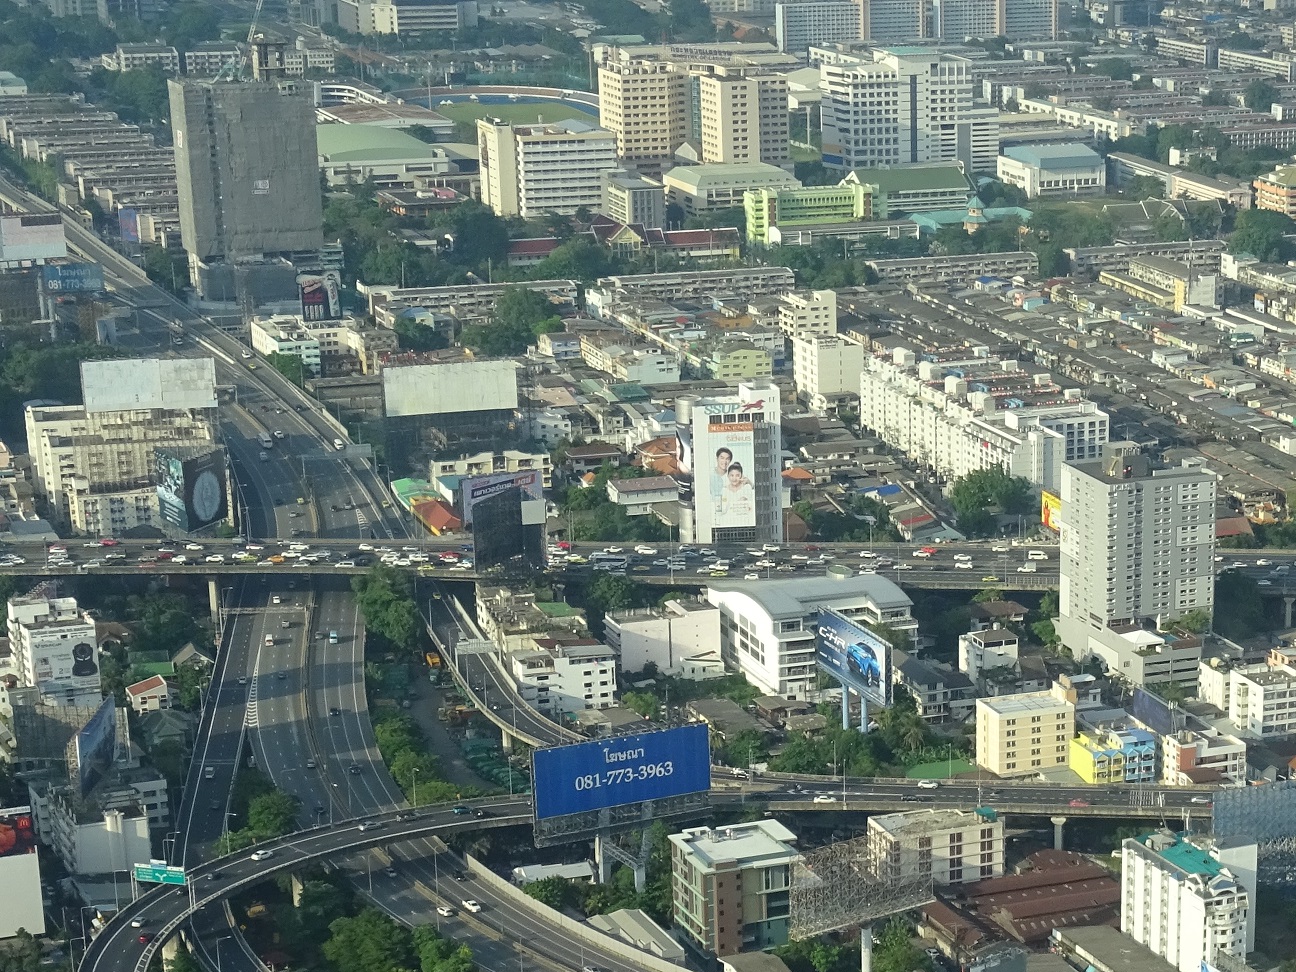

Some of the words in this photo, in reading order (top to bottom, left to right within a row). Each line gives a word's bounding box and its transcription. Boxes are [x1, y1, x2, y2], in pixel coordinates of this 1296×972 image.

[704, 403, 741, 415] SSUP
[819, 626, 846, 649] C-HR
[603, 747, 645, 764] โฆษณา
[575, 761, 674, 791] 081-773-3963
